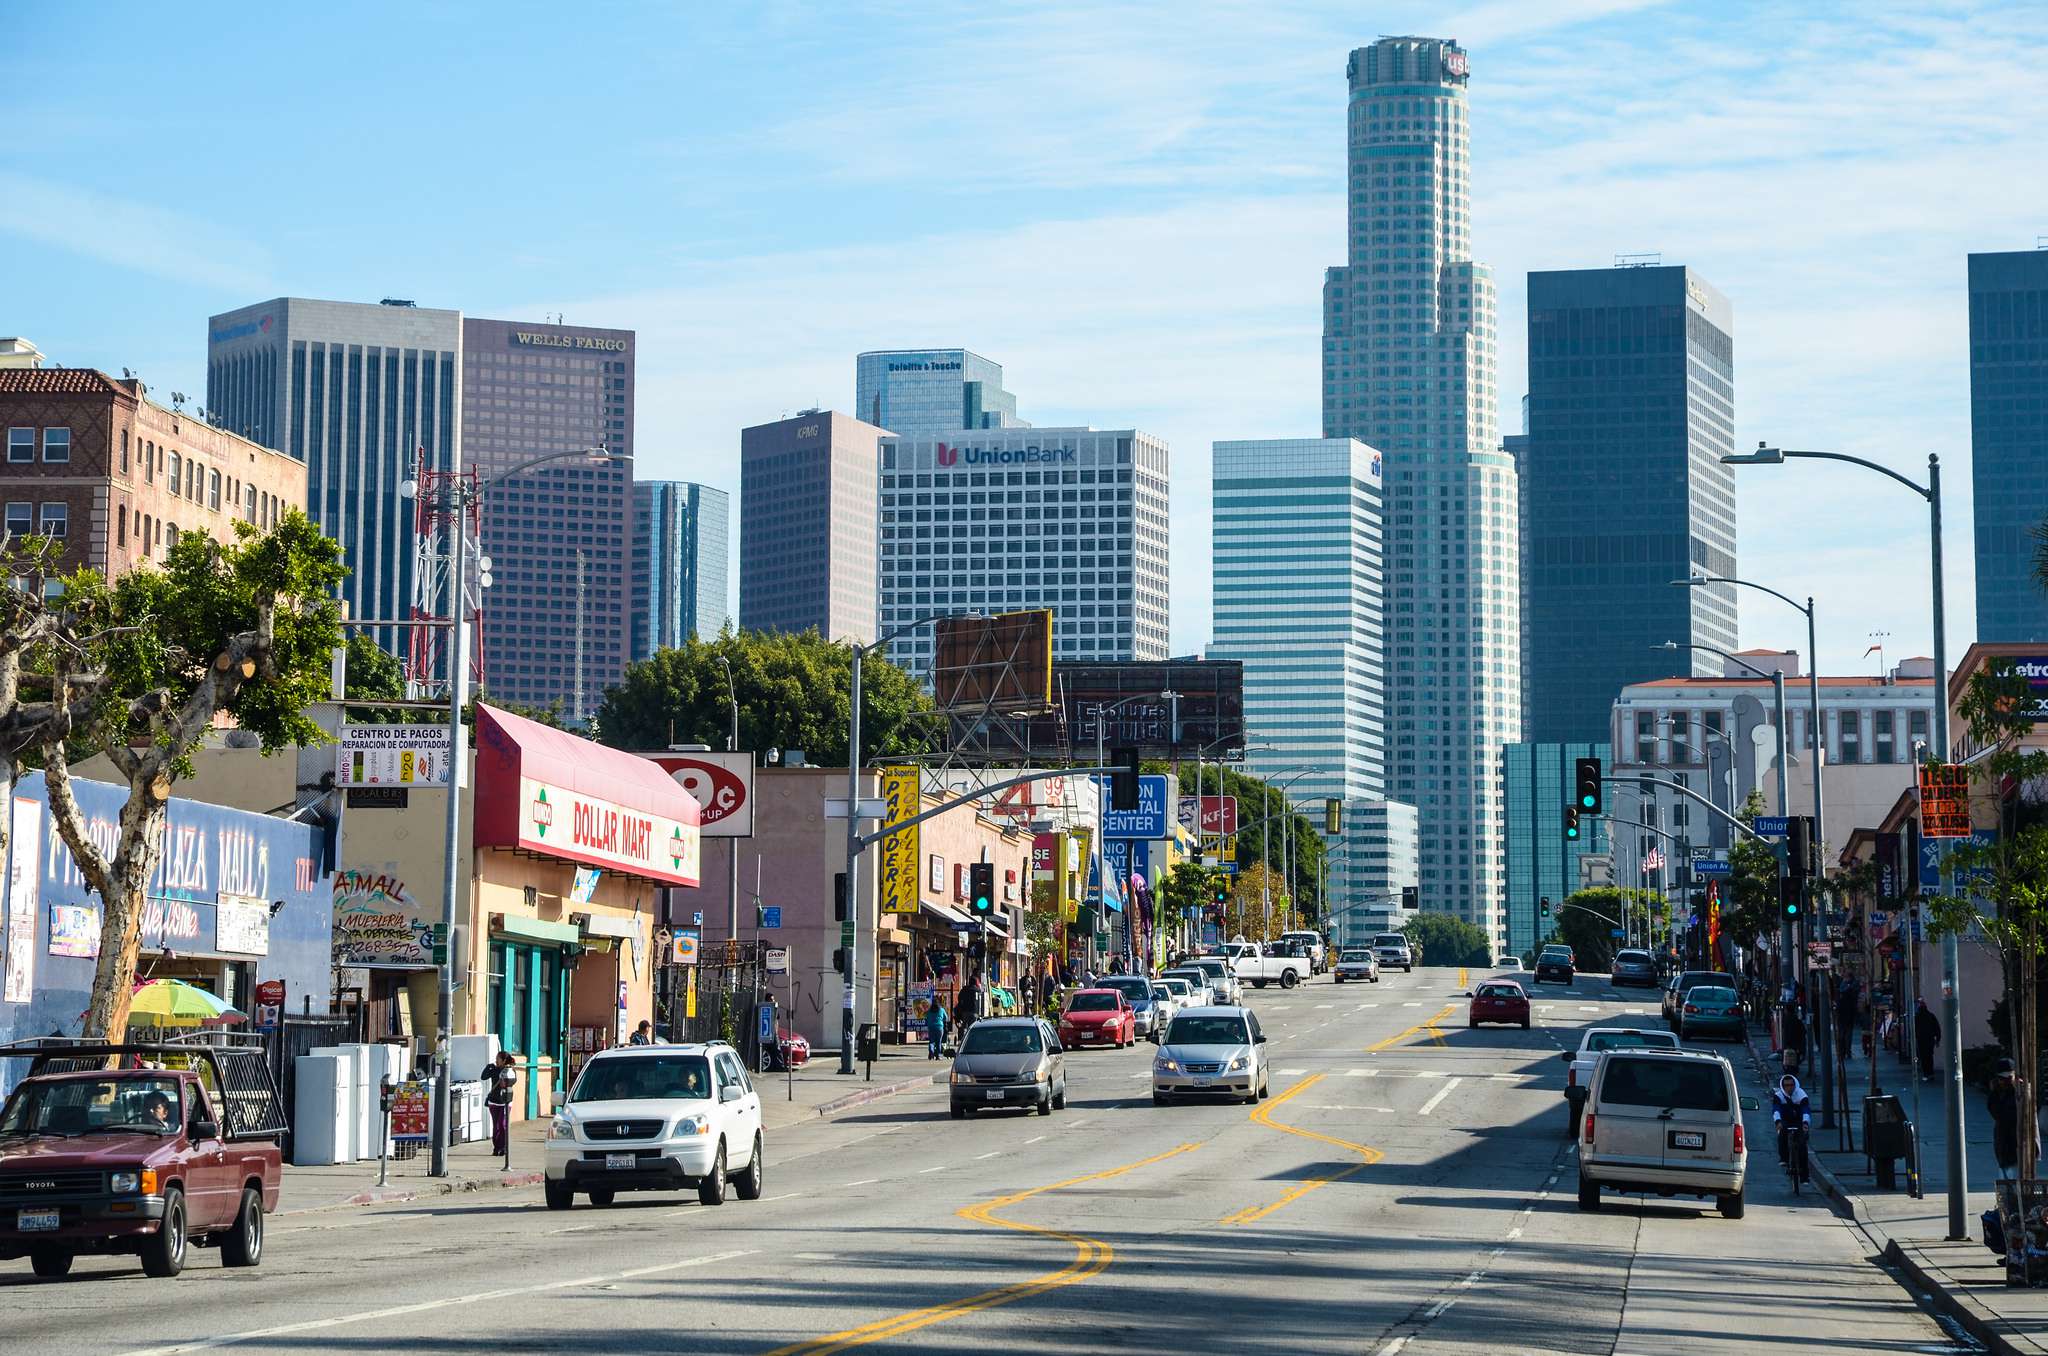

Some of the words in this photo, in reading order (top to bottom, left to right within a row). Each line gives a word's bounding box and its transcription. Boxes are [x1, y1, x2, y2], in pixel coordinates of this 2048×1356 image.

[517, 332, 571, 348] WELLS
[576, 336, 626, 352] FARGO
[797, 423, 819, 440] KPMG
[965, 445, 1075, 464] UnionBank
[1996, 662, 2048, 677] etro
[351, 729, 391, 739] CENTRO
[394, 729, 407, 739] DE
[410, 729, 442, 739] PAGOS
[342, 740, 386, 749] REPARACION
[388, 740, 397, 749] DE
[886, 768, 893, 777] La
[894, 768, 917, 779] Superior
[1202, 807, 1230, 825] KFC
[574, 801, 618, 853] DOLLAR
[622, 814, 652, 861] MART
[901, 780, 917, 910] TORILLERIA
[218, 829, 256, 897] MALL
[1697, 862, 1717, 870] Union
[355, 873, 405, 903] MALL
[363, 928, 416, 940] DEPORTES
[25, 1181, 56, 1189] TOYOTA
